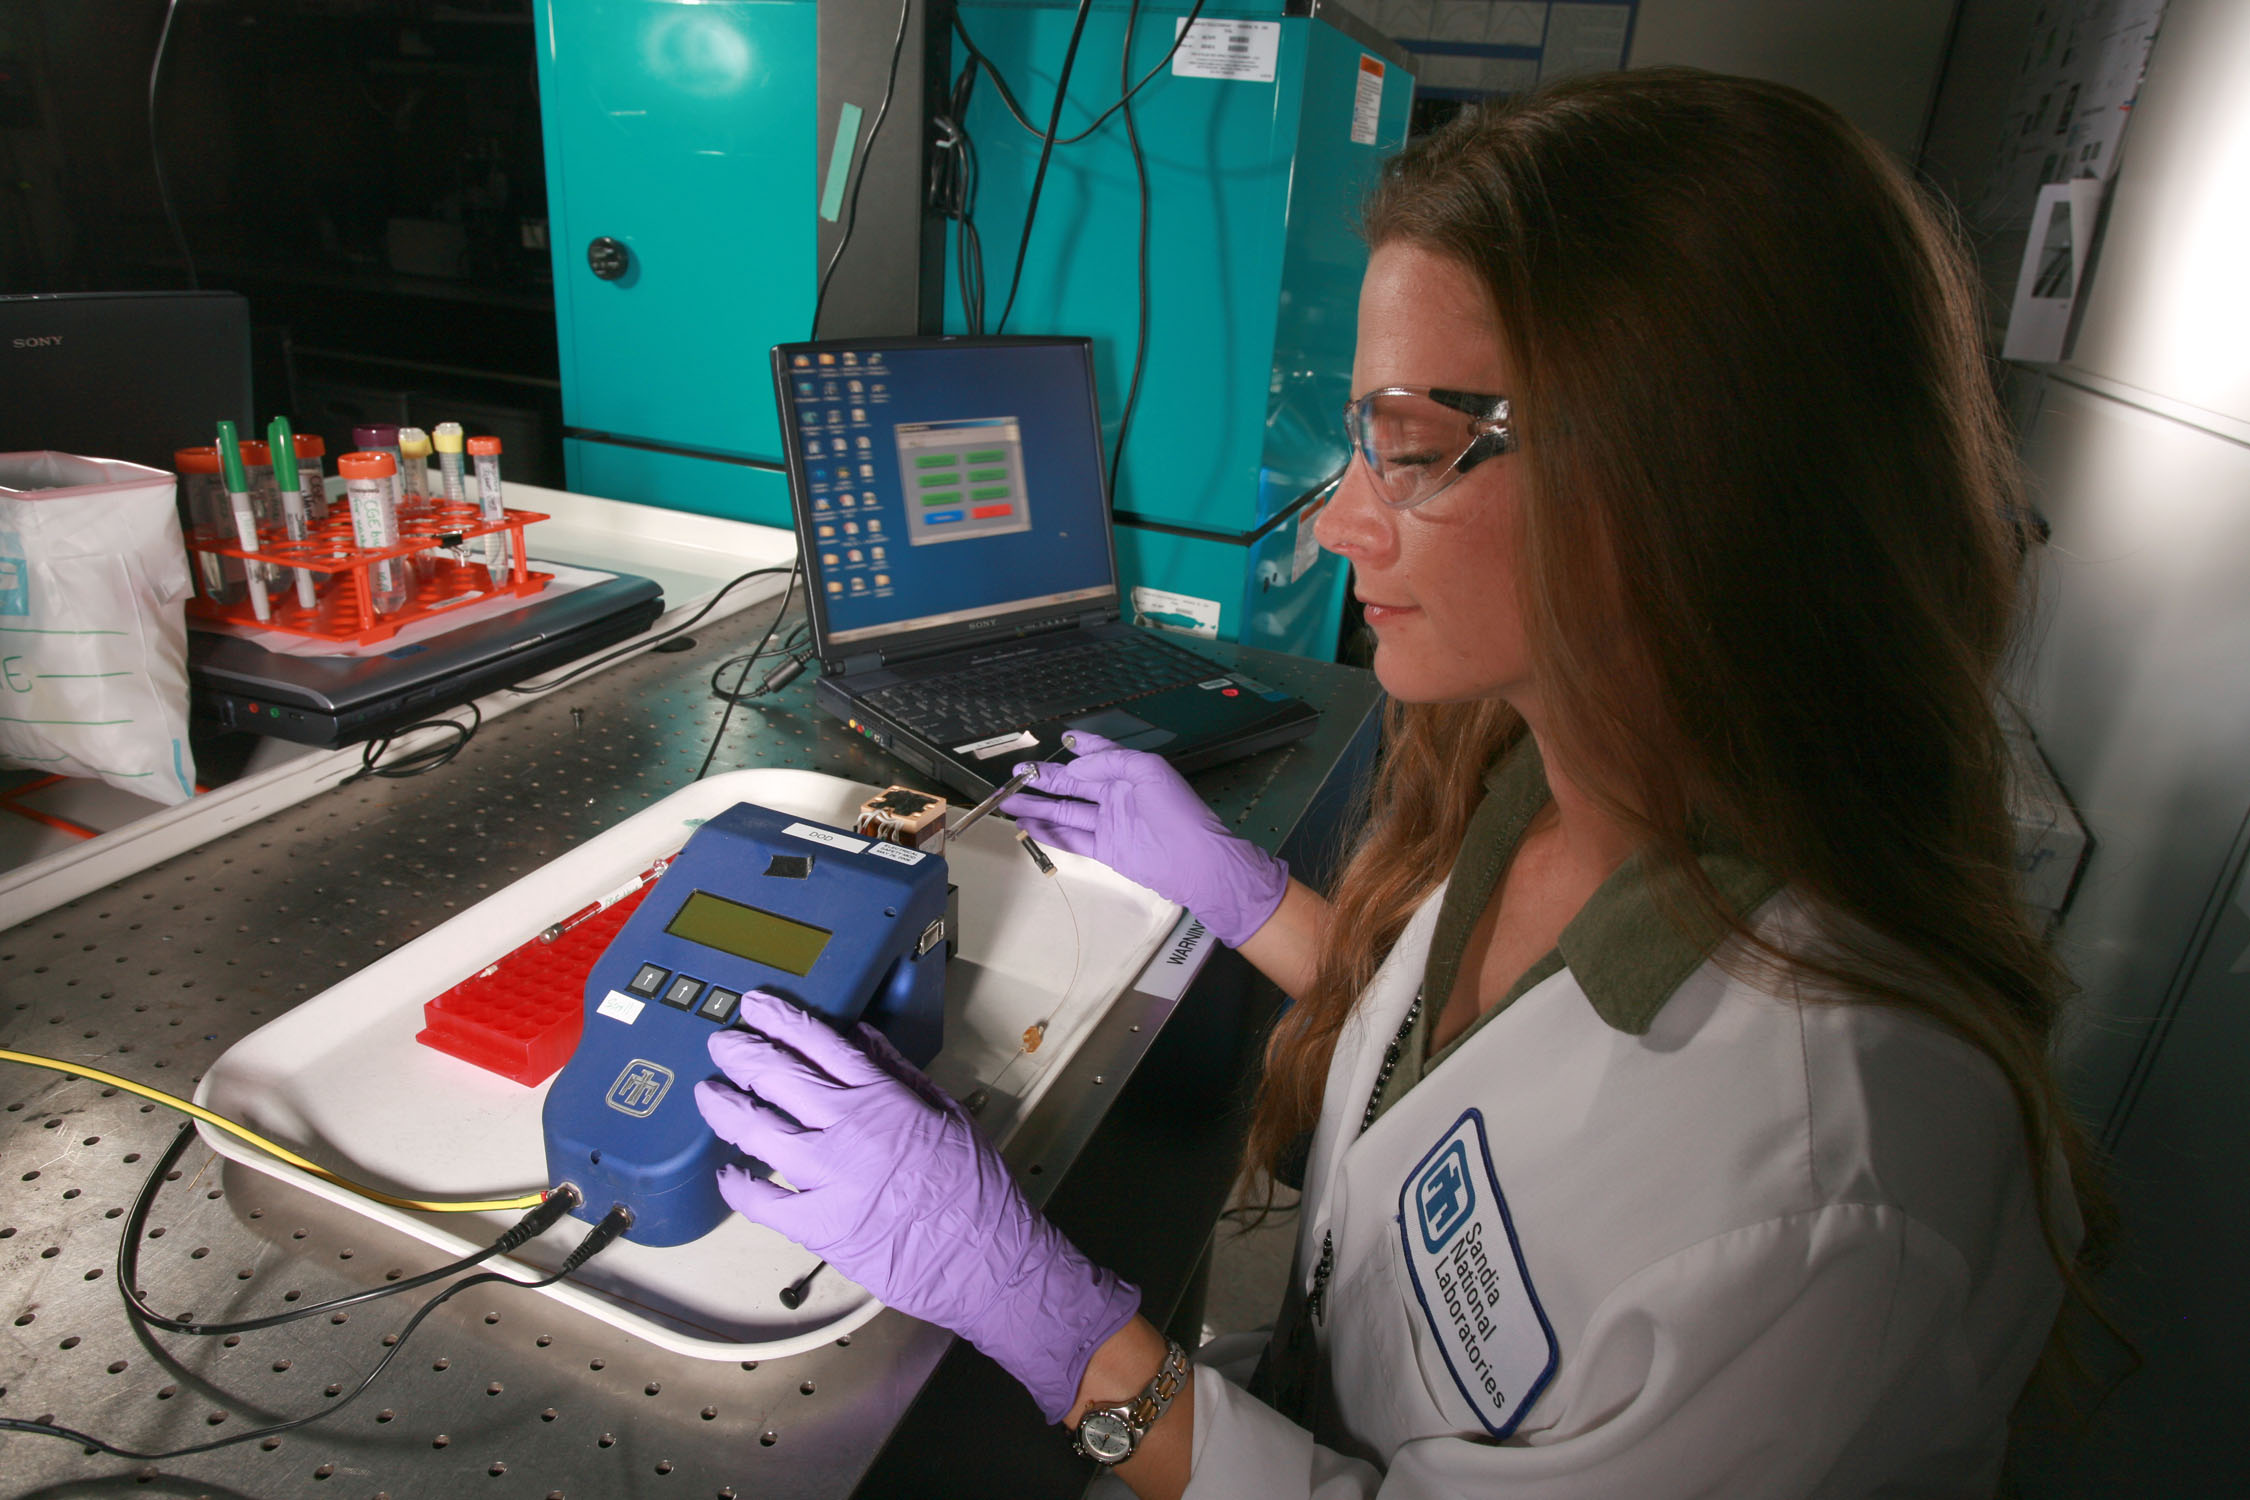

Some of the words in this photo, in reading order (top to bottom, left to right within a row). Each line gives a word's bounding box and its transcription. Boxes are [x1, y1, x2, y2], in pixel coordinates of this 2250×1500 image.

[12, 335, 64, 349] SONY
[363, 498, 380, 527] CGE
[969, 619, 996, 630] SONY
[809, 831, 833, 841] DOD
[880, 847, 902, 856] SAFETY
[884, 844, 918, 857] ELECTRICAL
[1166, 919, 1207, 965] WARNIN
[1465, 1222, 1500, 1309] Sandia
[1450, 1239, 1497, 1343] National
[1434, 1257, 1505, 1409] Laboratories
